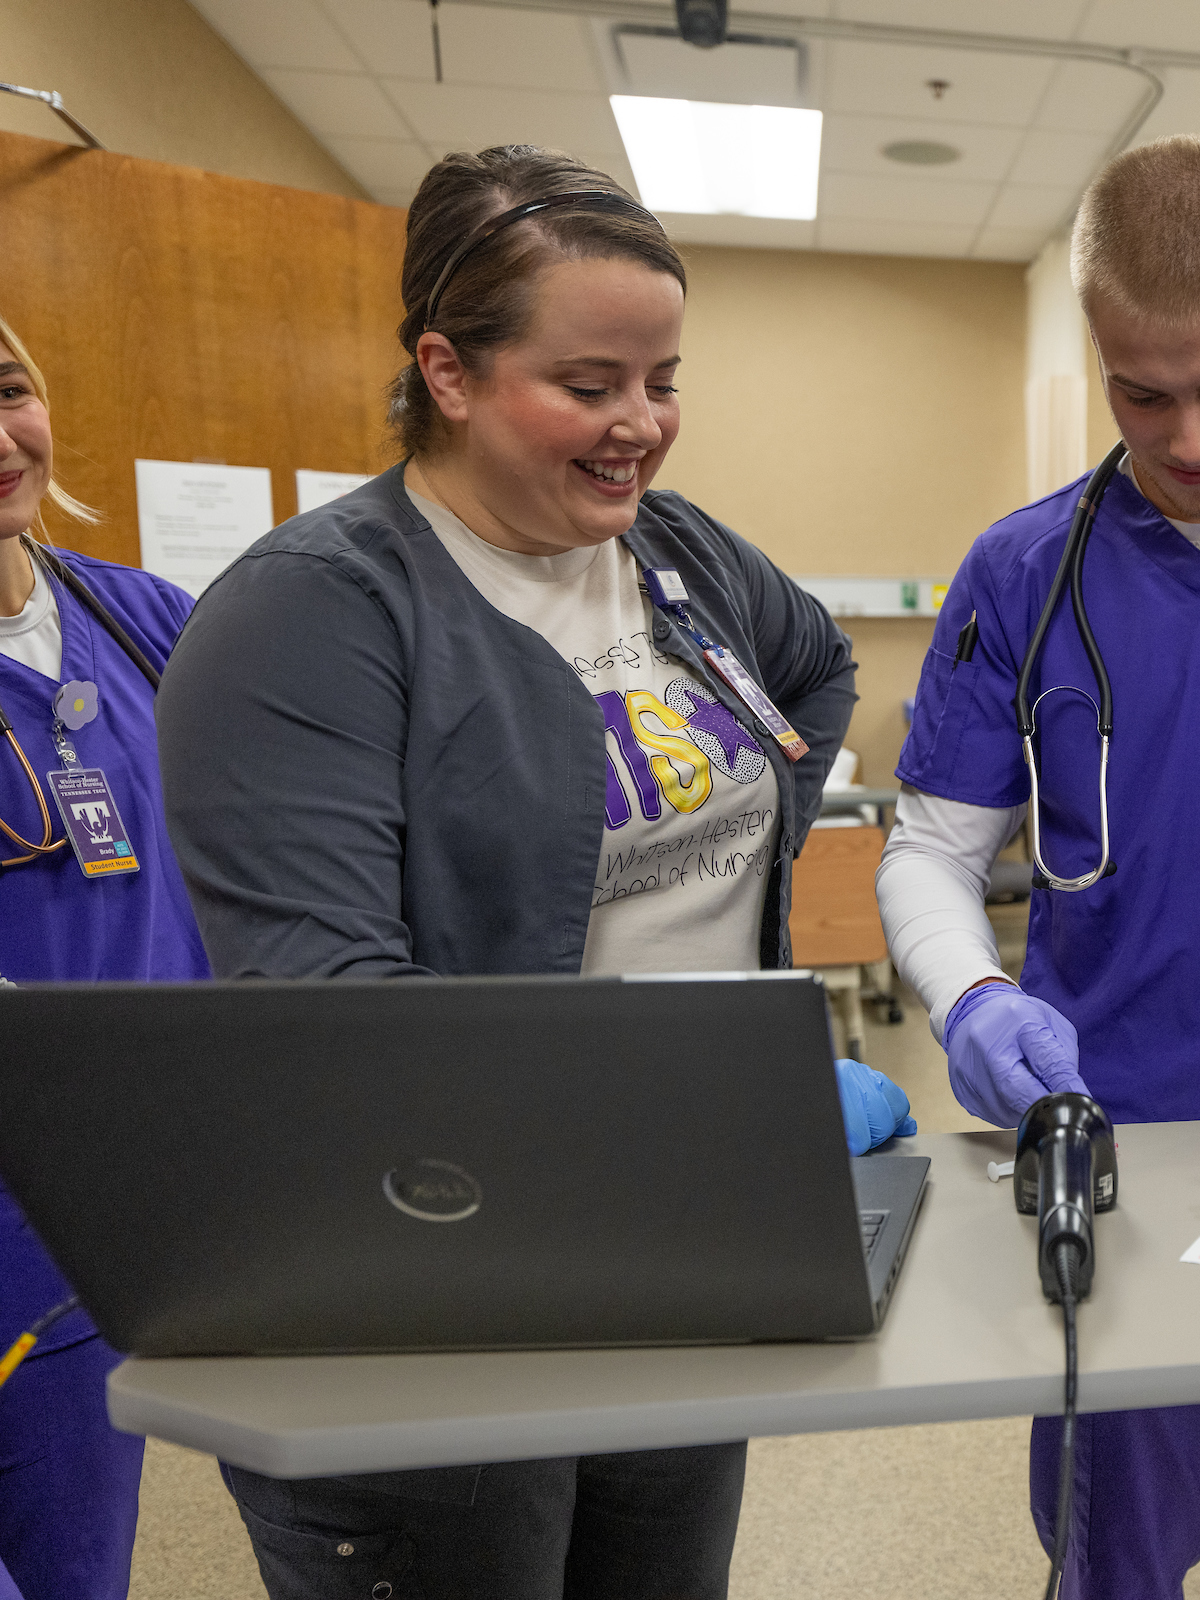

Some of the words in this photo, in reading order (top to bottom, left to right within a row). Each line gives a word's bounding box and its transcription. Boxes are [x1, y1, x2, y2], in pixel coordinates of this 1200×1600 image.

[60, 789, 92, 797] TENNESSEE
[99, 847, 115, 855] Brady
[90, 861, 116, 871] Student
[116, 859, 133, 867] Nurse
[594, 863, 661, 904] chool
[669, 852, 694, 886] of
